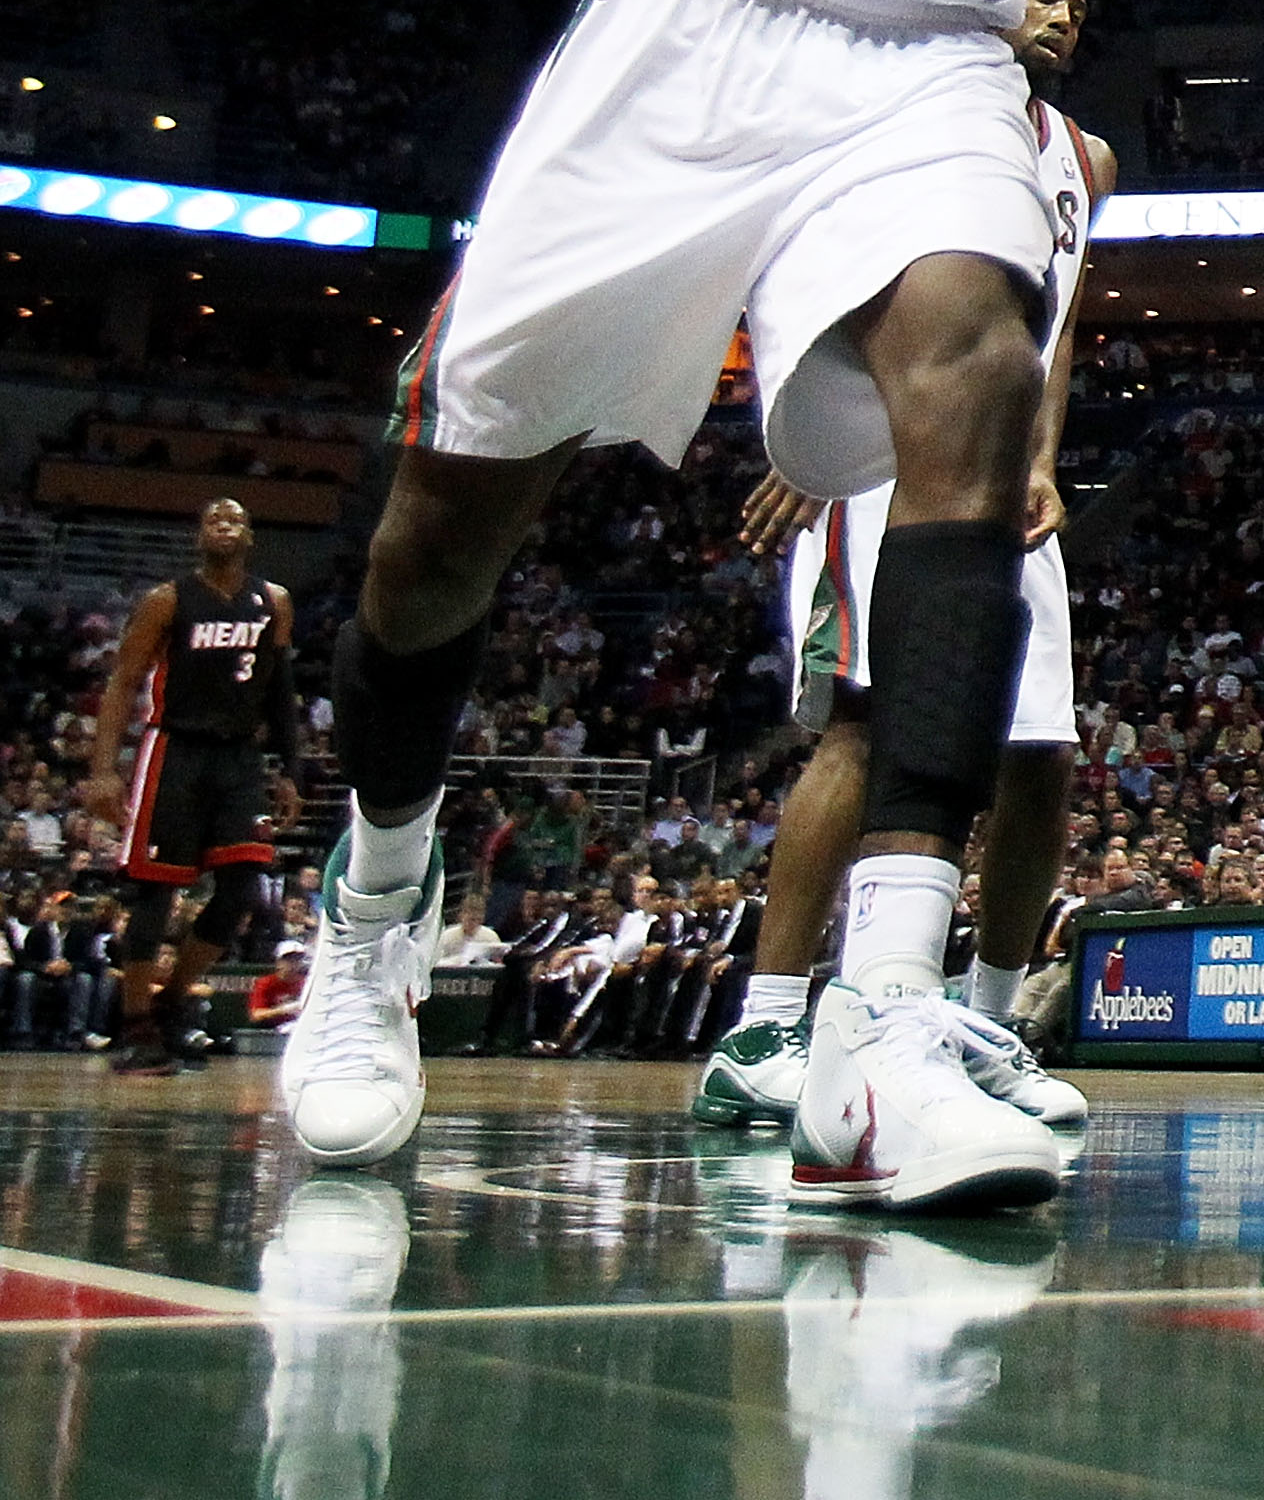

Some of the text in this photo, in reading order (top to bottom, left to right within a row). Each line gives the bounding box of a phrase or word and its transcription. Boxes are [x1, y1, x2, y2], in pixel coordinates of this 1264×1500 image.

[190, 615, 271, 650] HEAT
[234, 652, 256, 681] 3
[1210, 936, 1253, 960] OPEN
[1089, 979, 1174, 1031] Applebee's
[1224, 1001, 1248, 1026] OR
